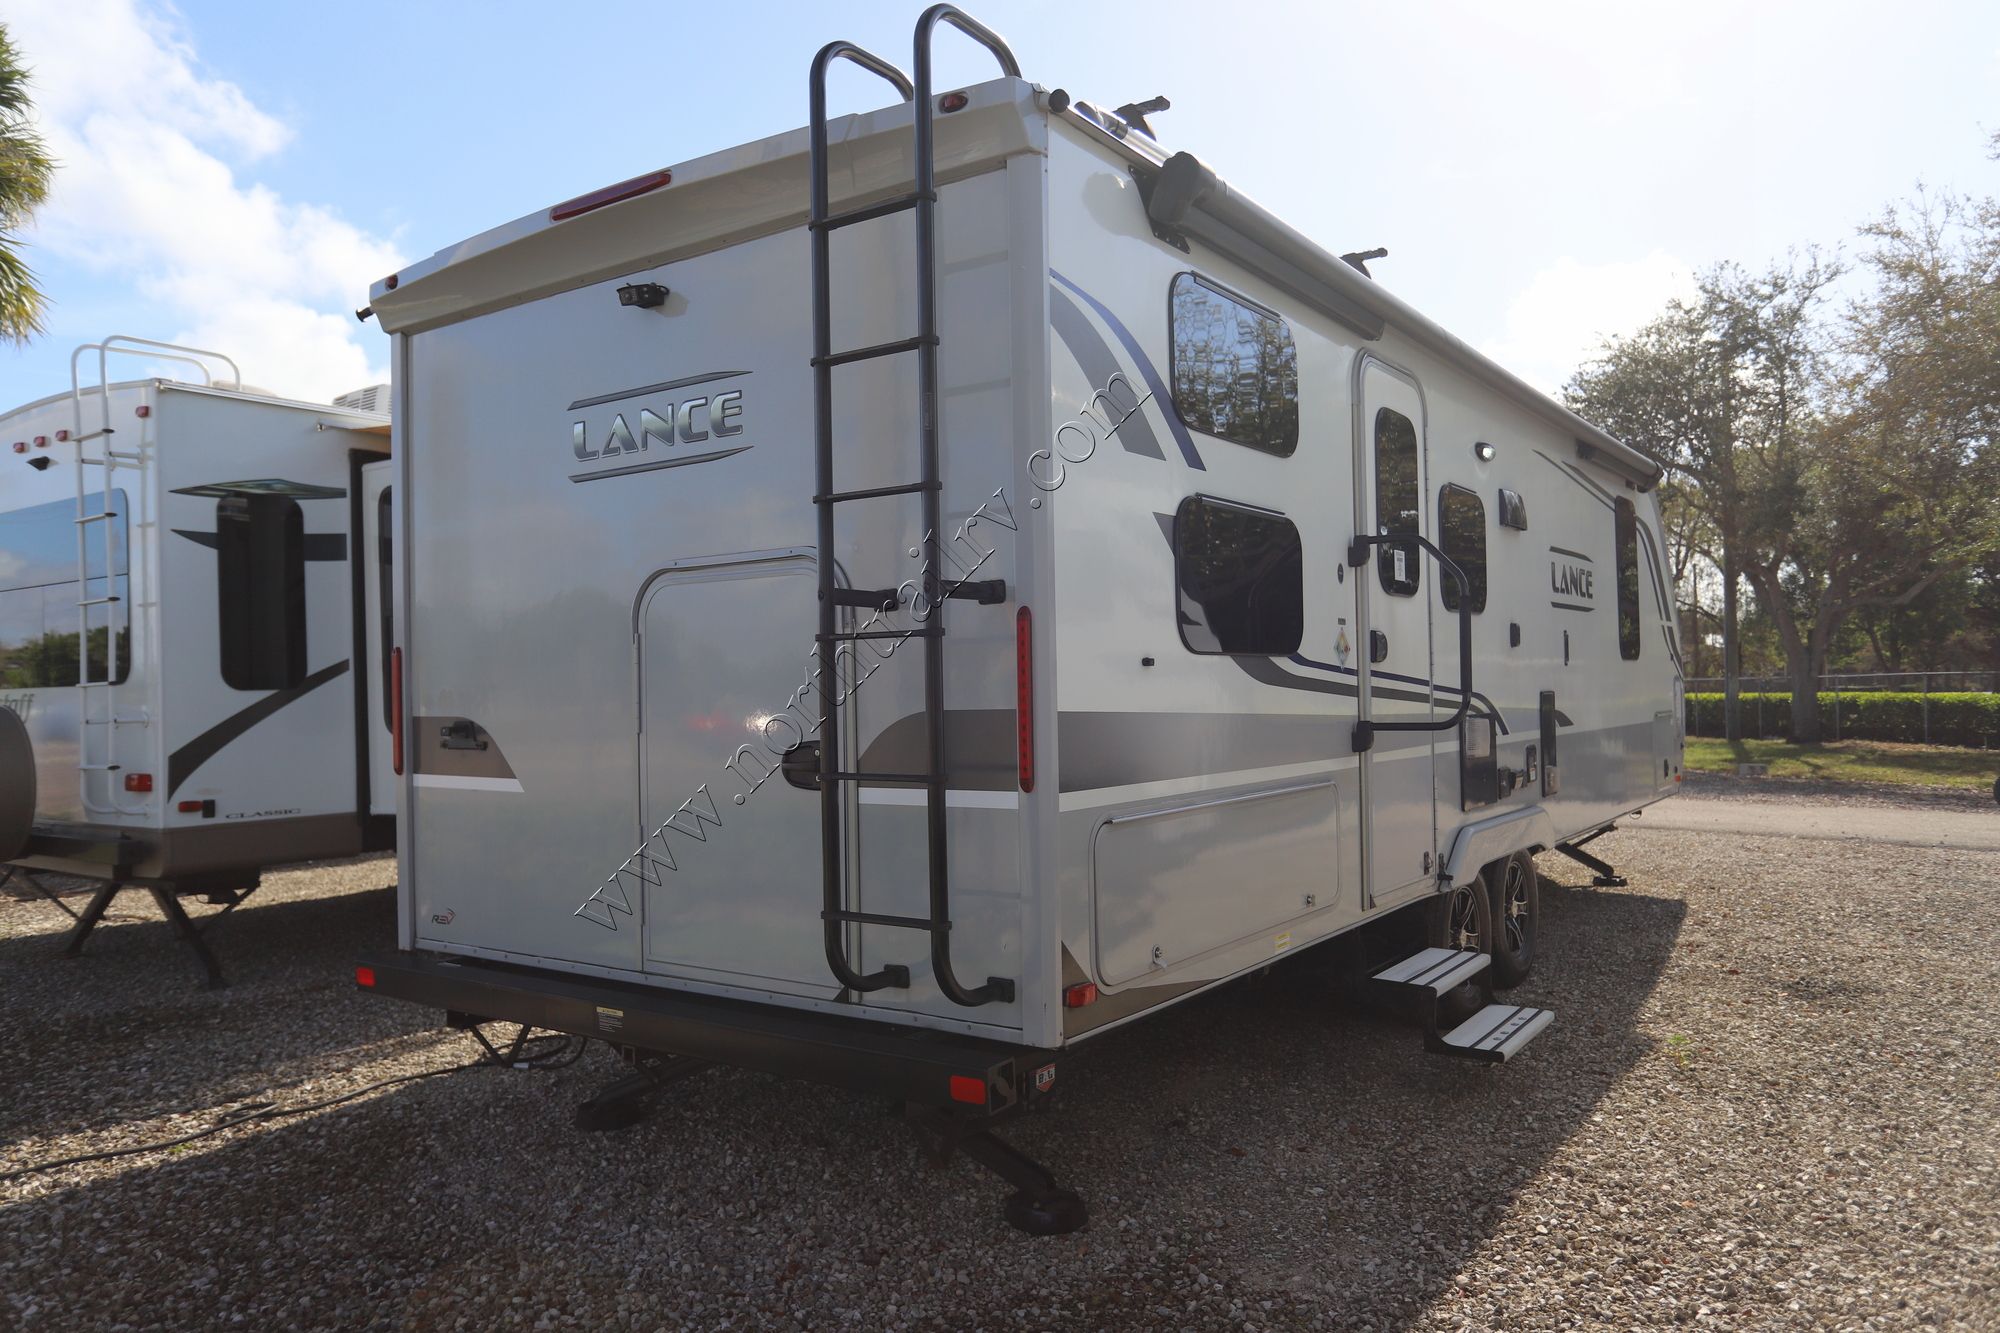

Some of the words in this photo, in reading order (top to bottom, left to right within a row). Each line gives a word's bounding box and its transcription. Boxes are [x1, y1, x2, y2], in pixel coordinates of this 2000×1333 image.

[573, 389, 744, 463] LANCE
[1551, 561, 1593, 600] LANCE
[225, 808, 301, 819] CLASSIC
